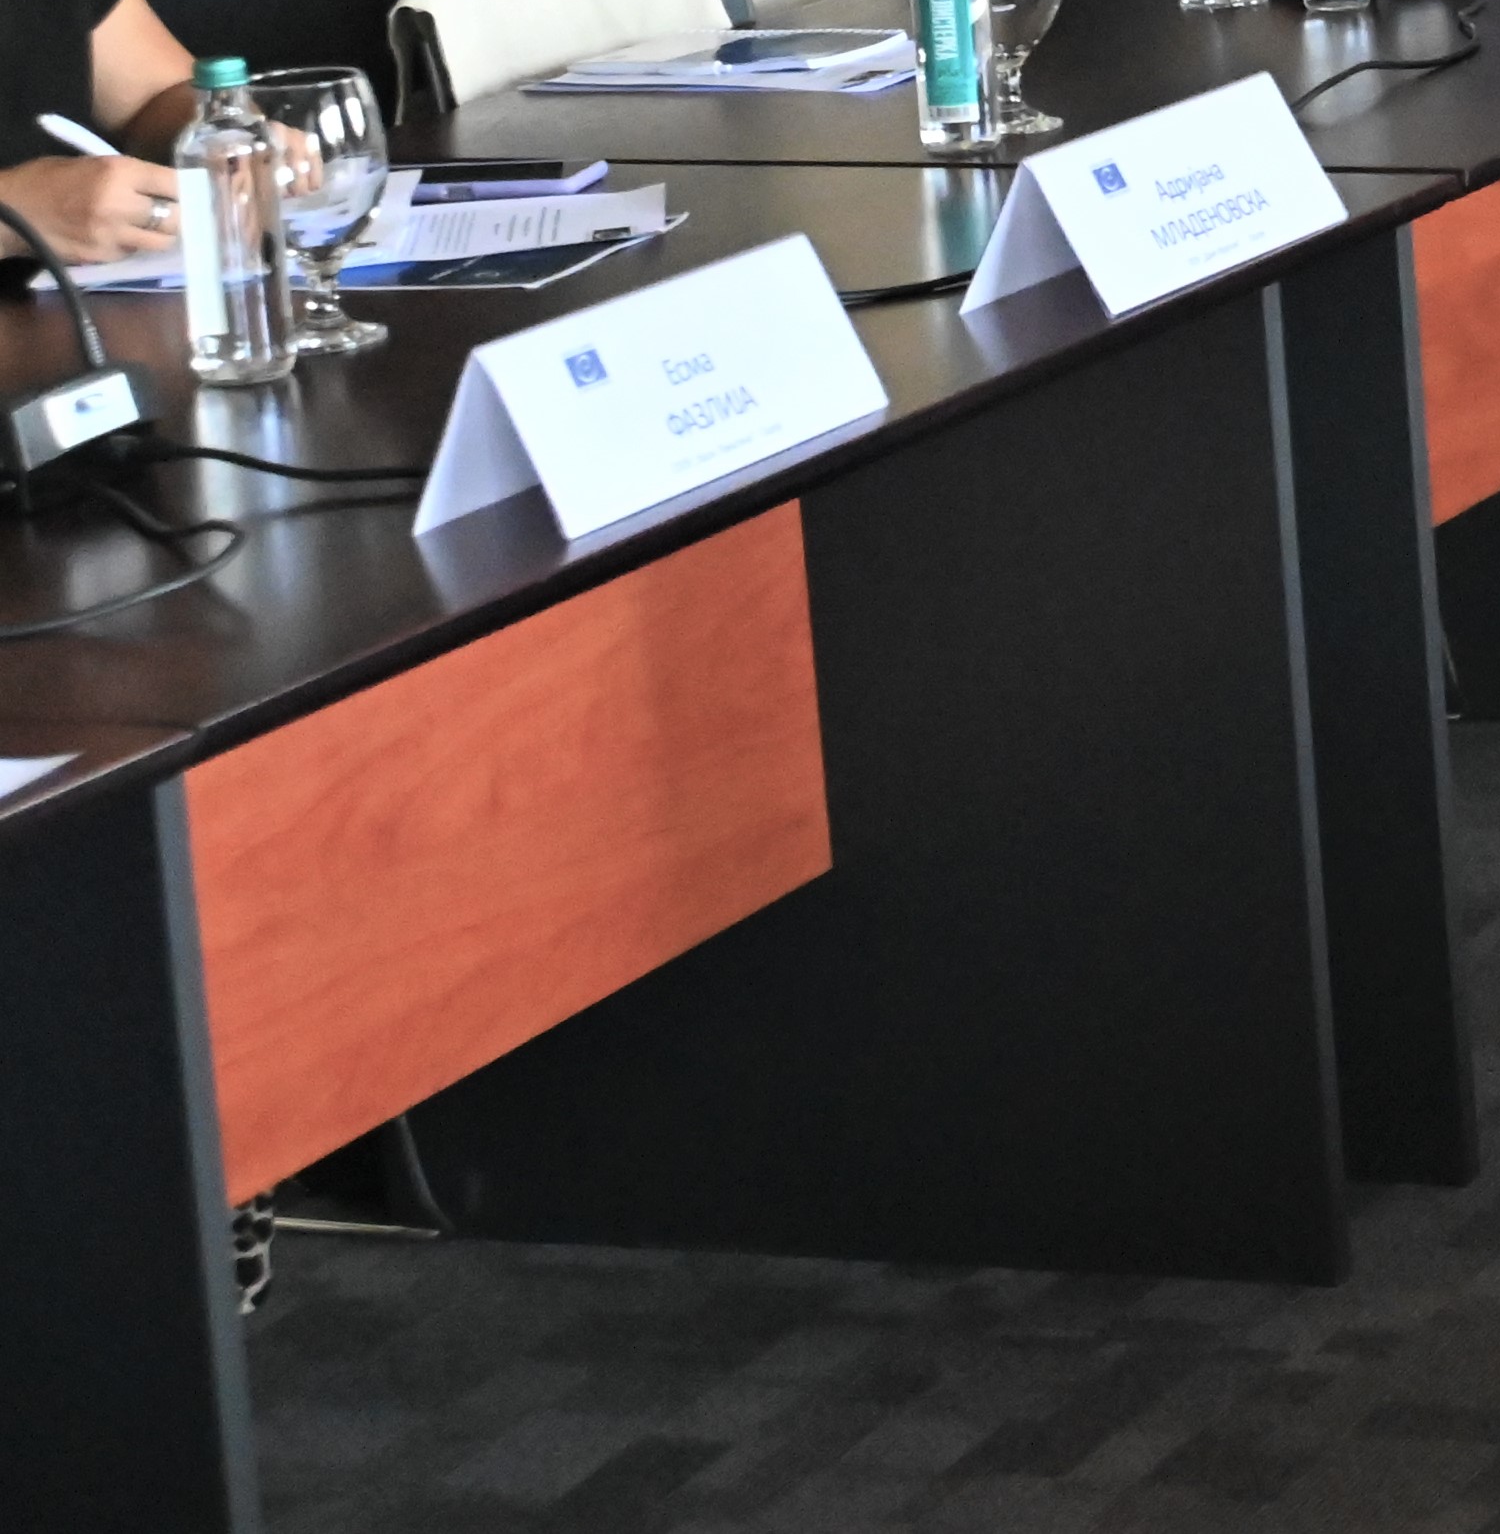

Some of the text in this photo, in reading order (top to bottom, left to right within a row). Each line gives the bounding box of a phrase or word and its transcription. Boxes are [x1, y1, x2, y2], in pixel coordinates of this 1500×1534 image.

[1154, 161, 1226, 204] Адријана
[1150, 187, 1271, 250] МЛАДЕНОВСКА
[661, 351, 716, 387] Есма
